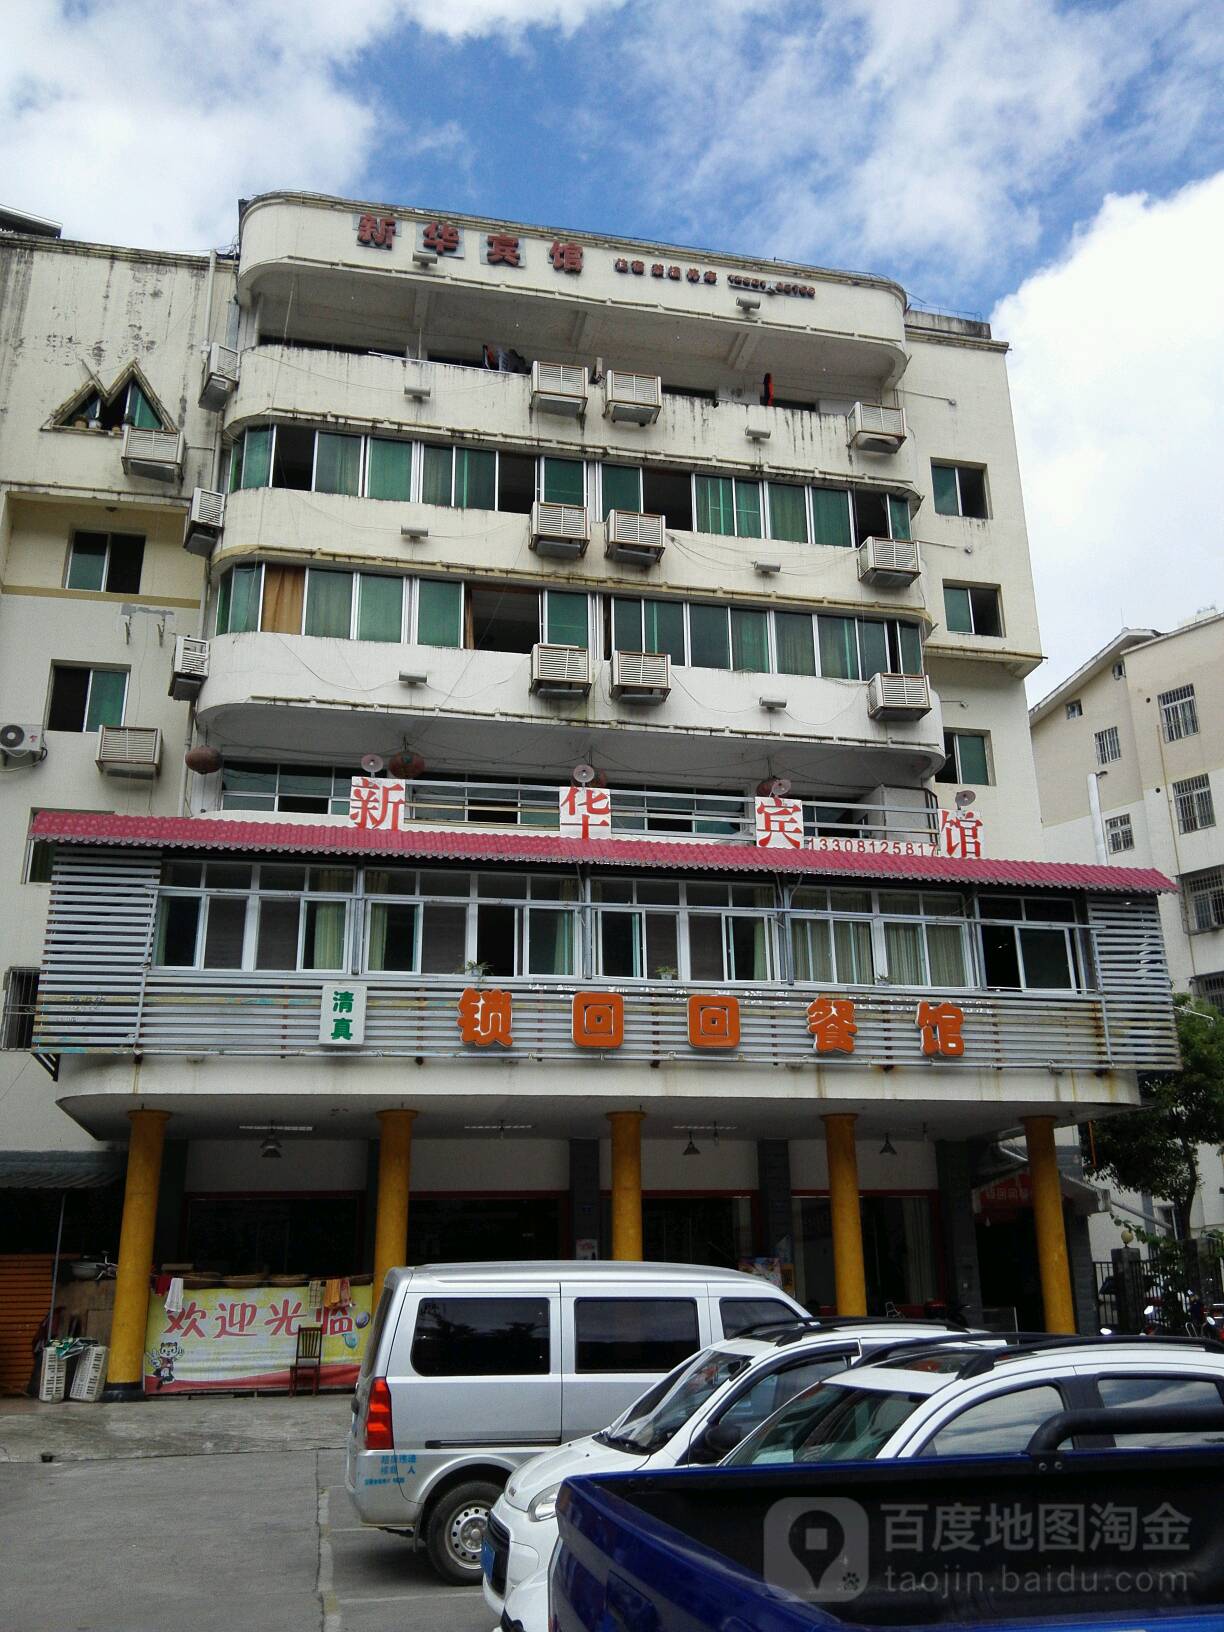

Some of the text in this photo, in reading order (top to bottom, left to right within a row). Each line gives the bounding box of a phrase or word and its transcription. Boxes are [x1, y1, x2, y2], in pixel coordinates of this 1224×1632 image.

[357, 213, 583, 274] 新华宾馆
[350, 777, 983, 858] 新华宾馆
[808, 838, 938, 855] 13308125817
[331, 991, 353, 1040] 清真
[457, 987, 964, 1056] 锁回回餐馆
[163, 1299, 353, 1338] 欢迎光临
